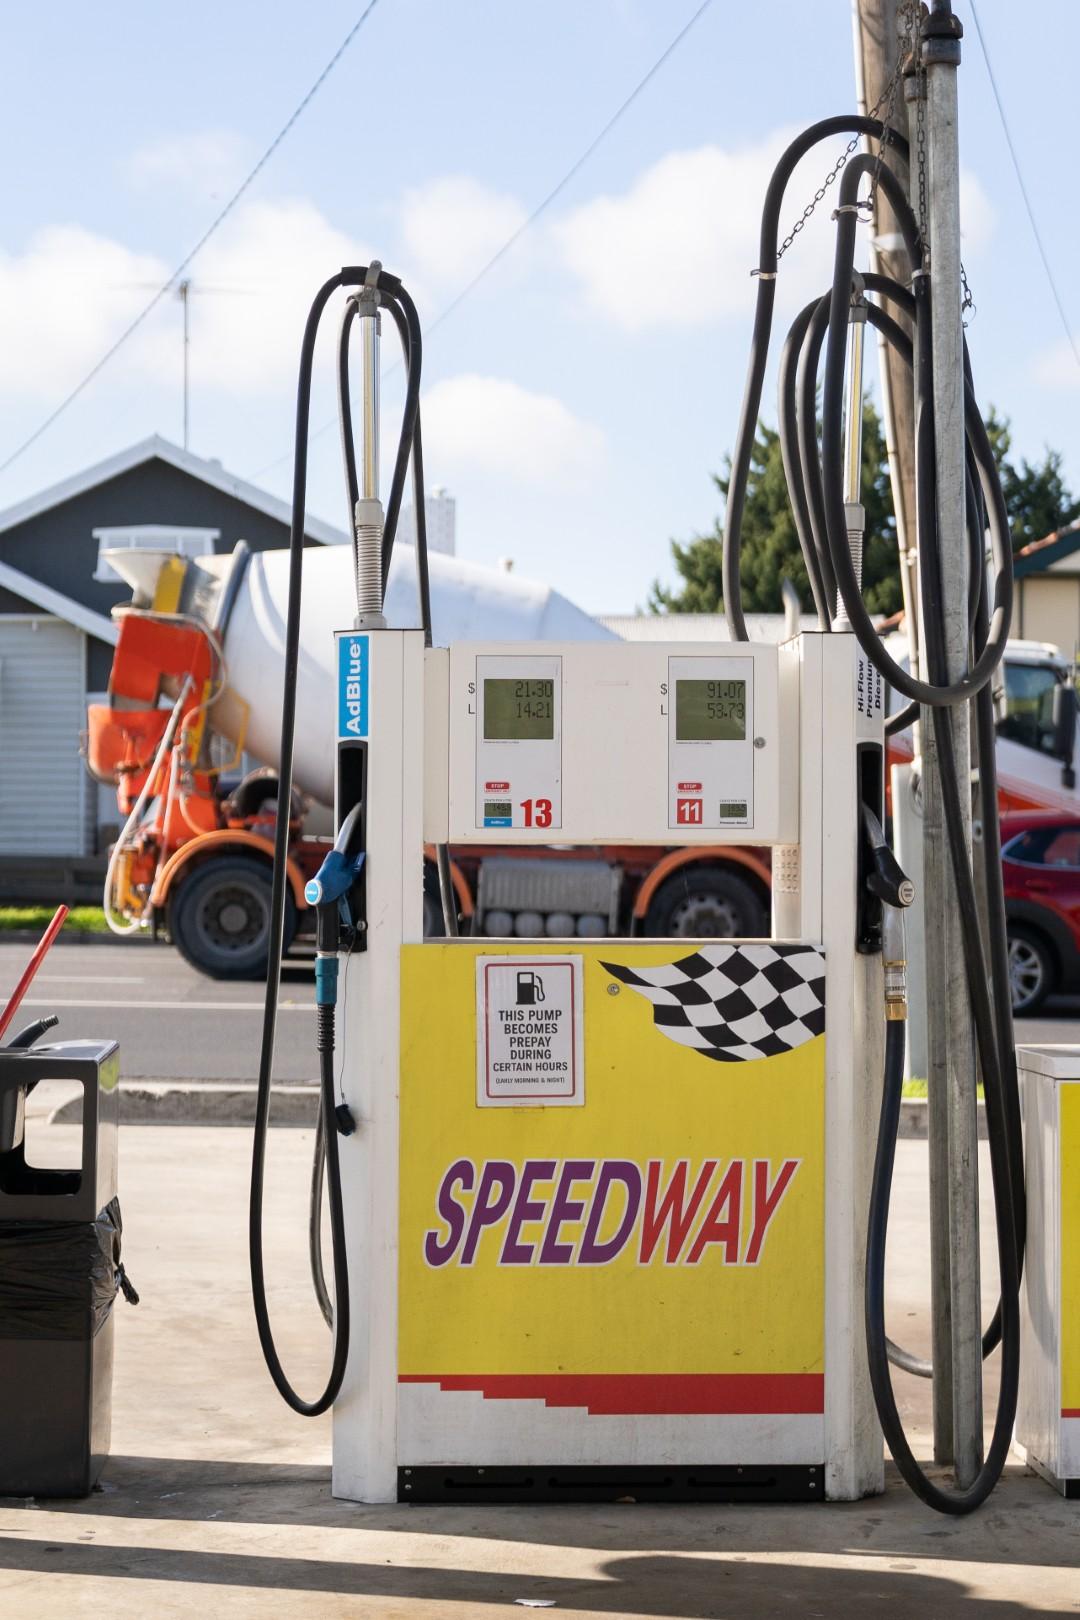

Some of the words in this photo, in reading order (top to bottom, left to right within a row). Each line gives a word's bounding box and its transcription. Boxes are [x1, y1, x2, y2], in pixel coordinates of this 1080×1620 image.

[468, 682, 476, 695] $
[515, 680, 553, 698] 21.30
[660, 683, 668, 696] $
[707, 681, 745, 699] 91.07
[468, 703, 476, 715] L
[516, 701, 551, 719] 14.21
[660, 704, 668, 716] L
[707, 702, 745, 720] 53.73
[520, 798, 552, 828] 13
[680, 801, 700, 822] 11
[498, 1010, 525, 1022] THIS
[528, 1009, 563, 1021] PUMP
[504, 1023, 558, 1035] BECOMES
[509, 1036, 552, 1048] PREPAY
[510, 1049, 552, 1060] DURING
[493, 1062, 533, 1072] CERTAIN
[535, 1062, 568, 1072] HOURS
[424, 1158, 800, 1267] SPEEDWAY
